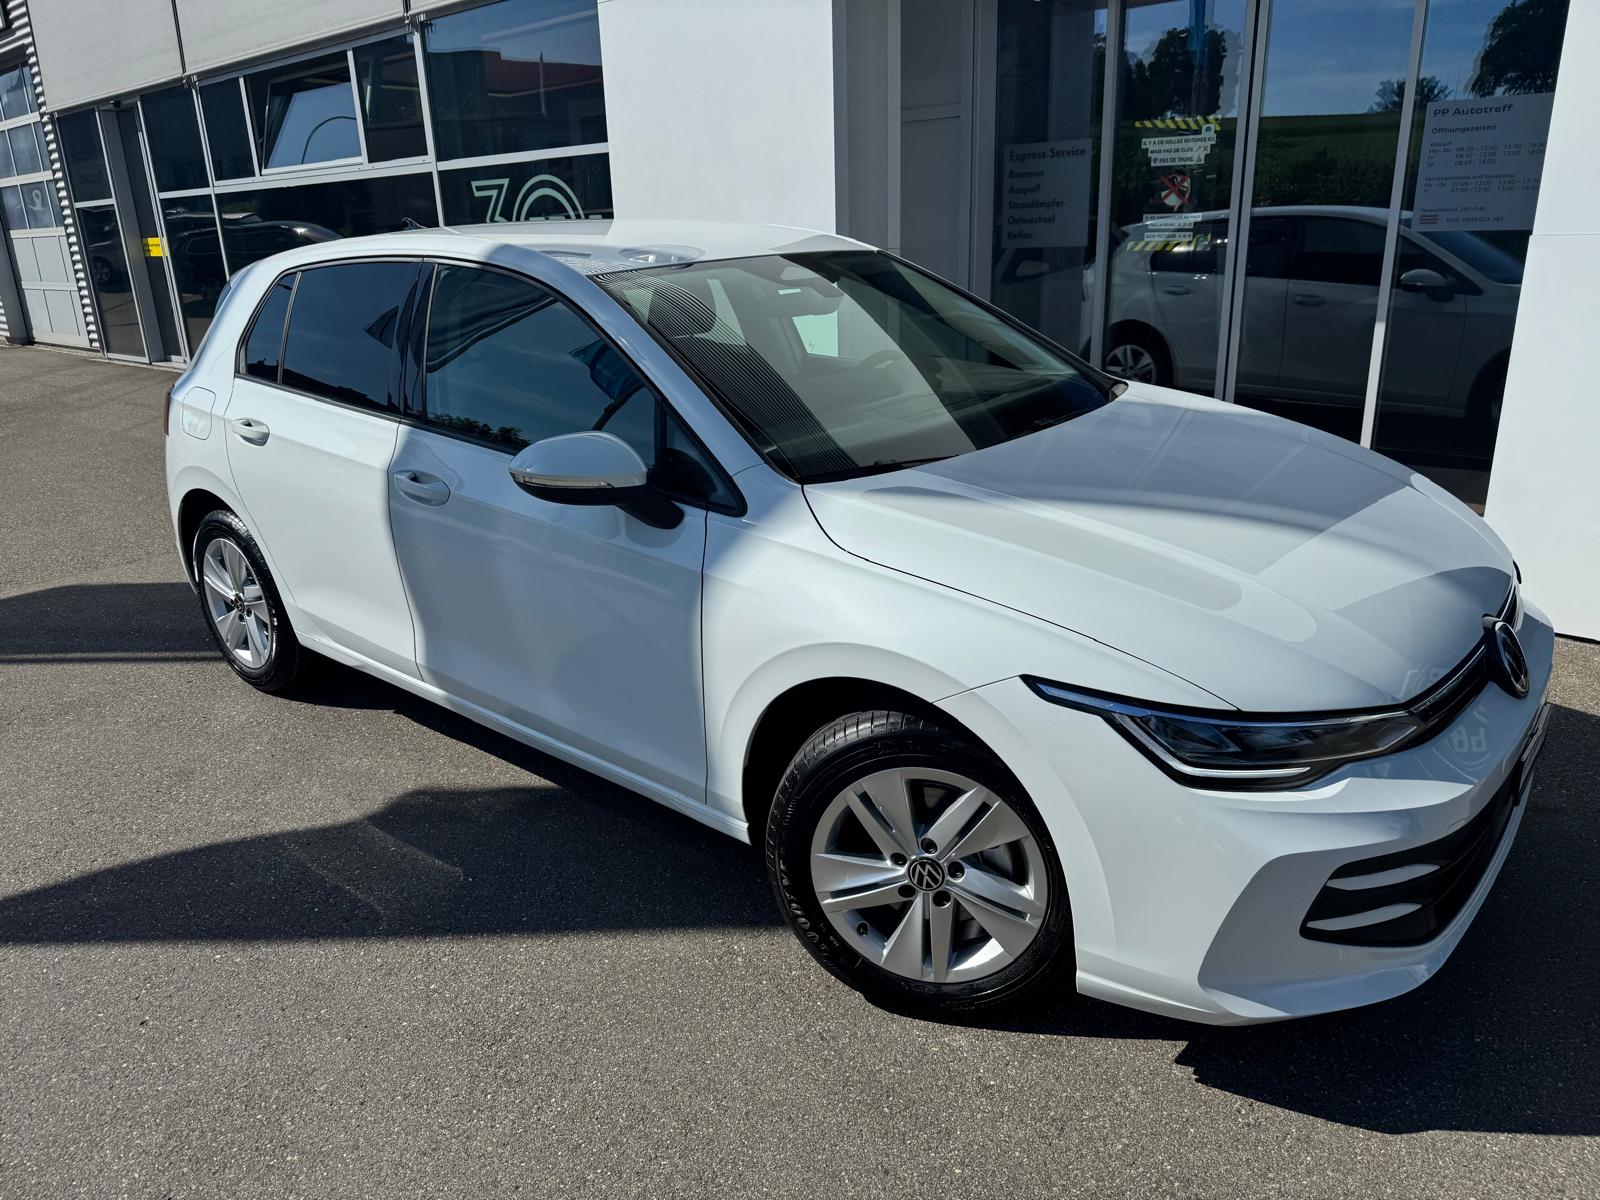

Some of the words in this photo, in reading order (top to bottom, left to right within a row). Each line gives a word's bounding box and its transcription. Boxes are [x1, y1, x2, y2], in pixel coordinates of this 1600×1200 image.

[1433, 108, 1449, 117] PP
[1452, 103, 1514, 116] Autotreff
[1431, 124, 1497, 134] Öffnungszeiten
[1009, 150, 1046, 163] Express
[1049, 145, 1087, 158] Service
